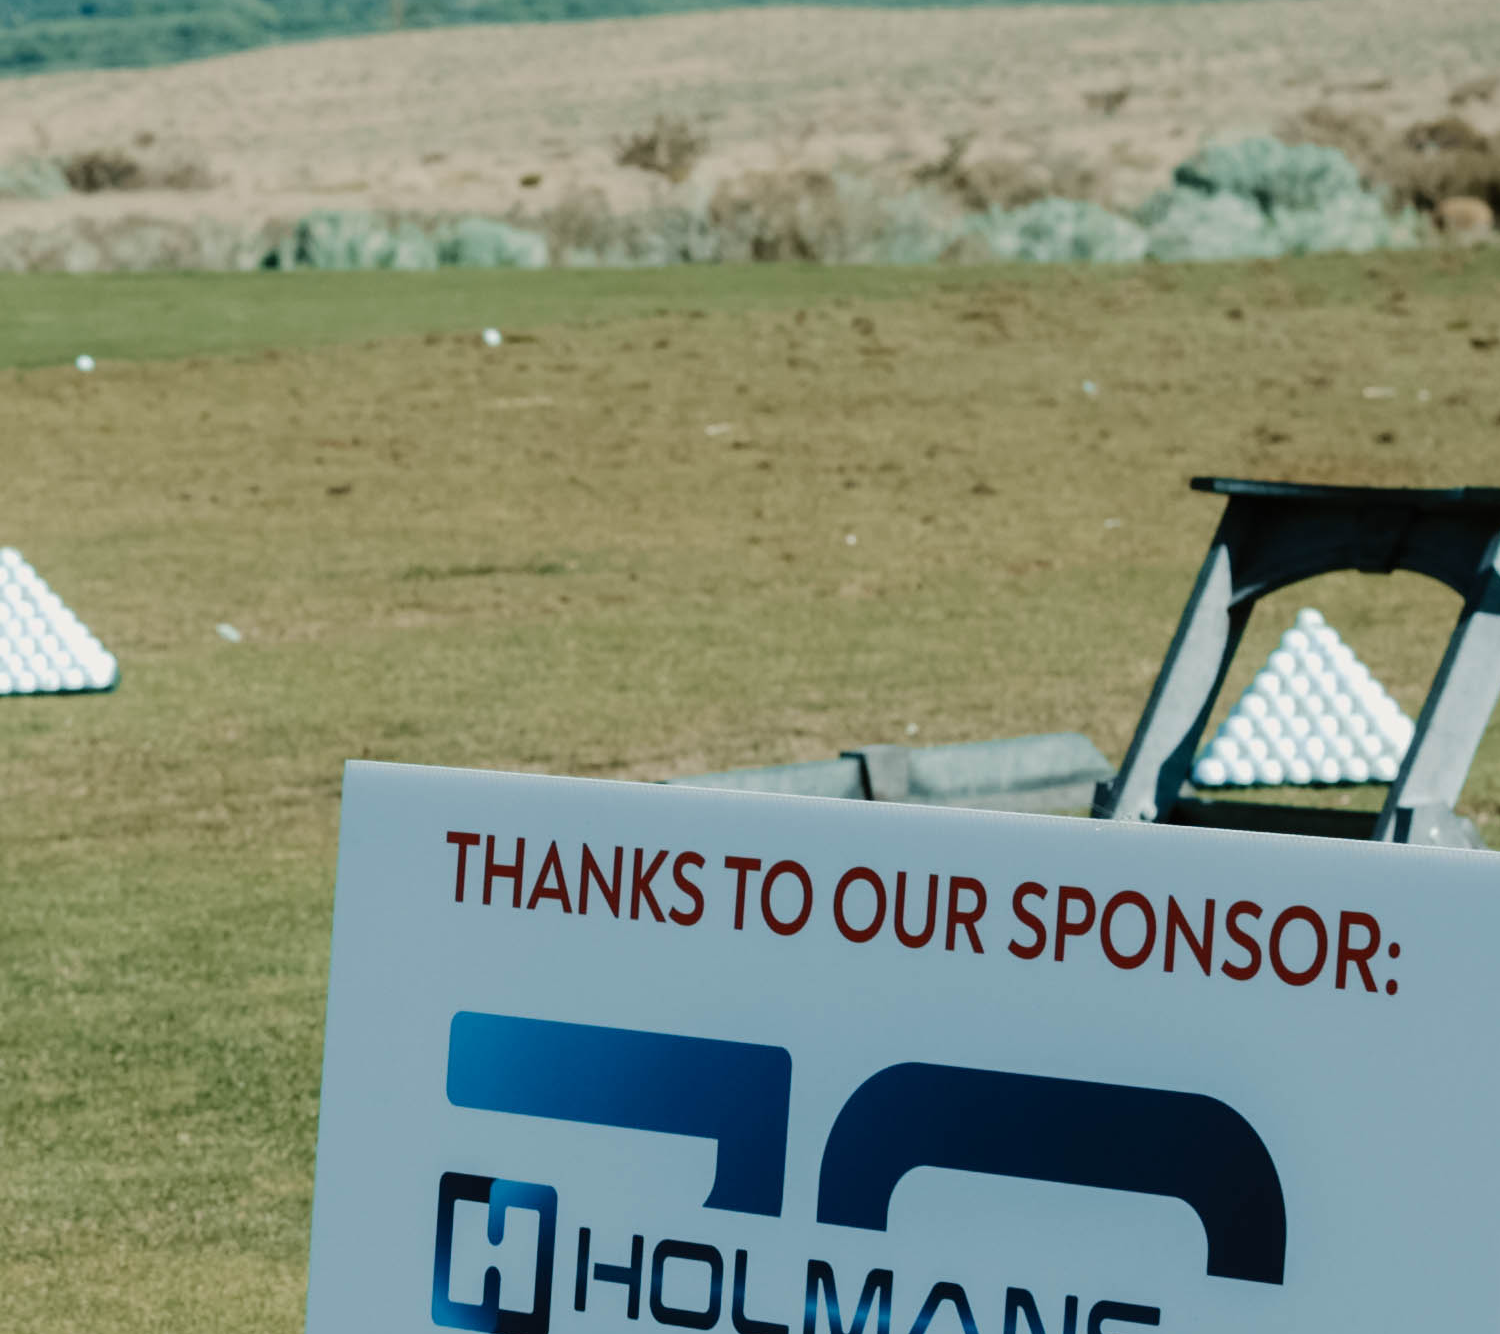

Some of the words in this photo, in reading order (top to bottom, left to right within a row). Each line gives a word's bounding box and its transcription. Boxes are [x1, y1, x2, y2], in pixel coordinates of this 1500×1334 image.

[446, 830, 706, 927] THANKS
[724, 855, 813, 936] TO
[833, 866, 988, 955] OUR
[1007, 881, 1401, 996] SPONSOR:
